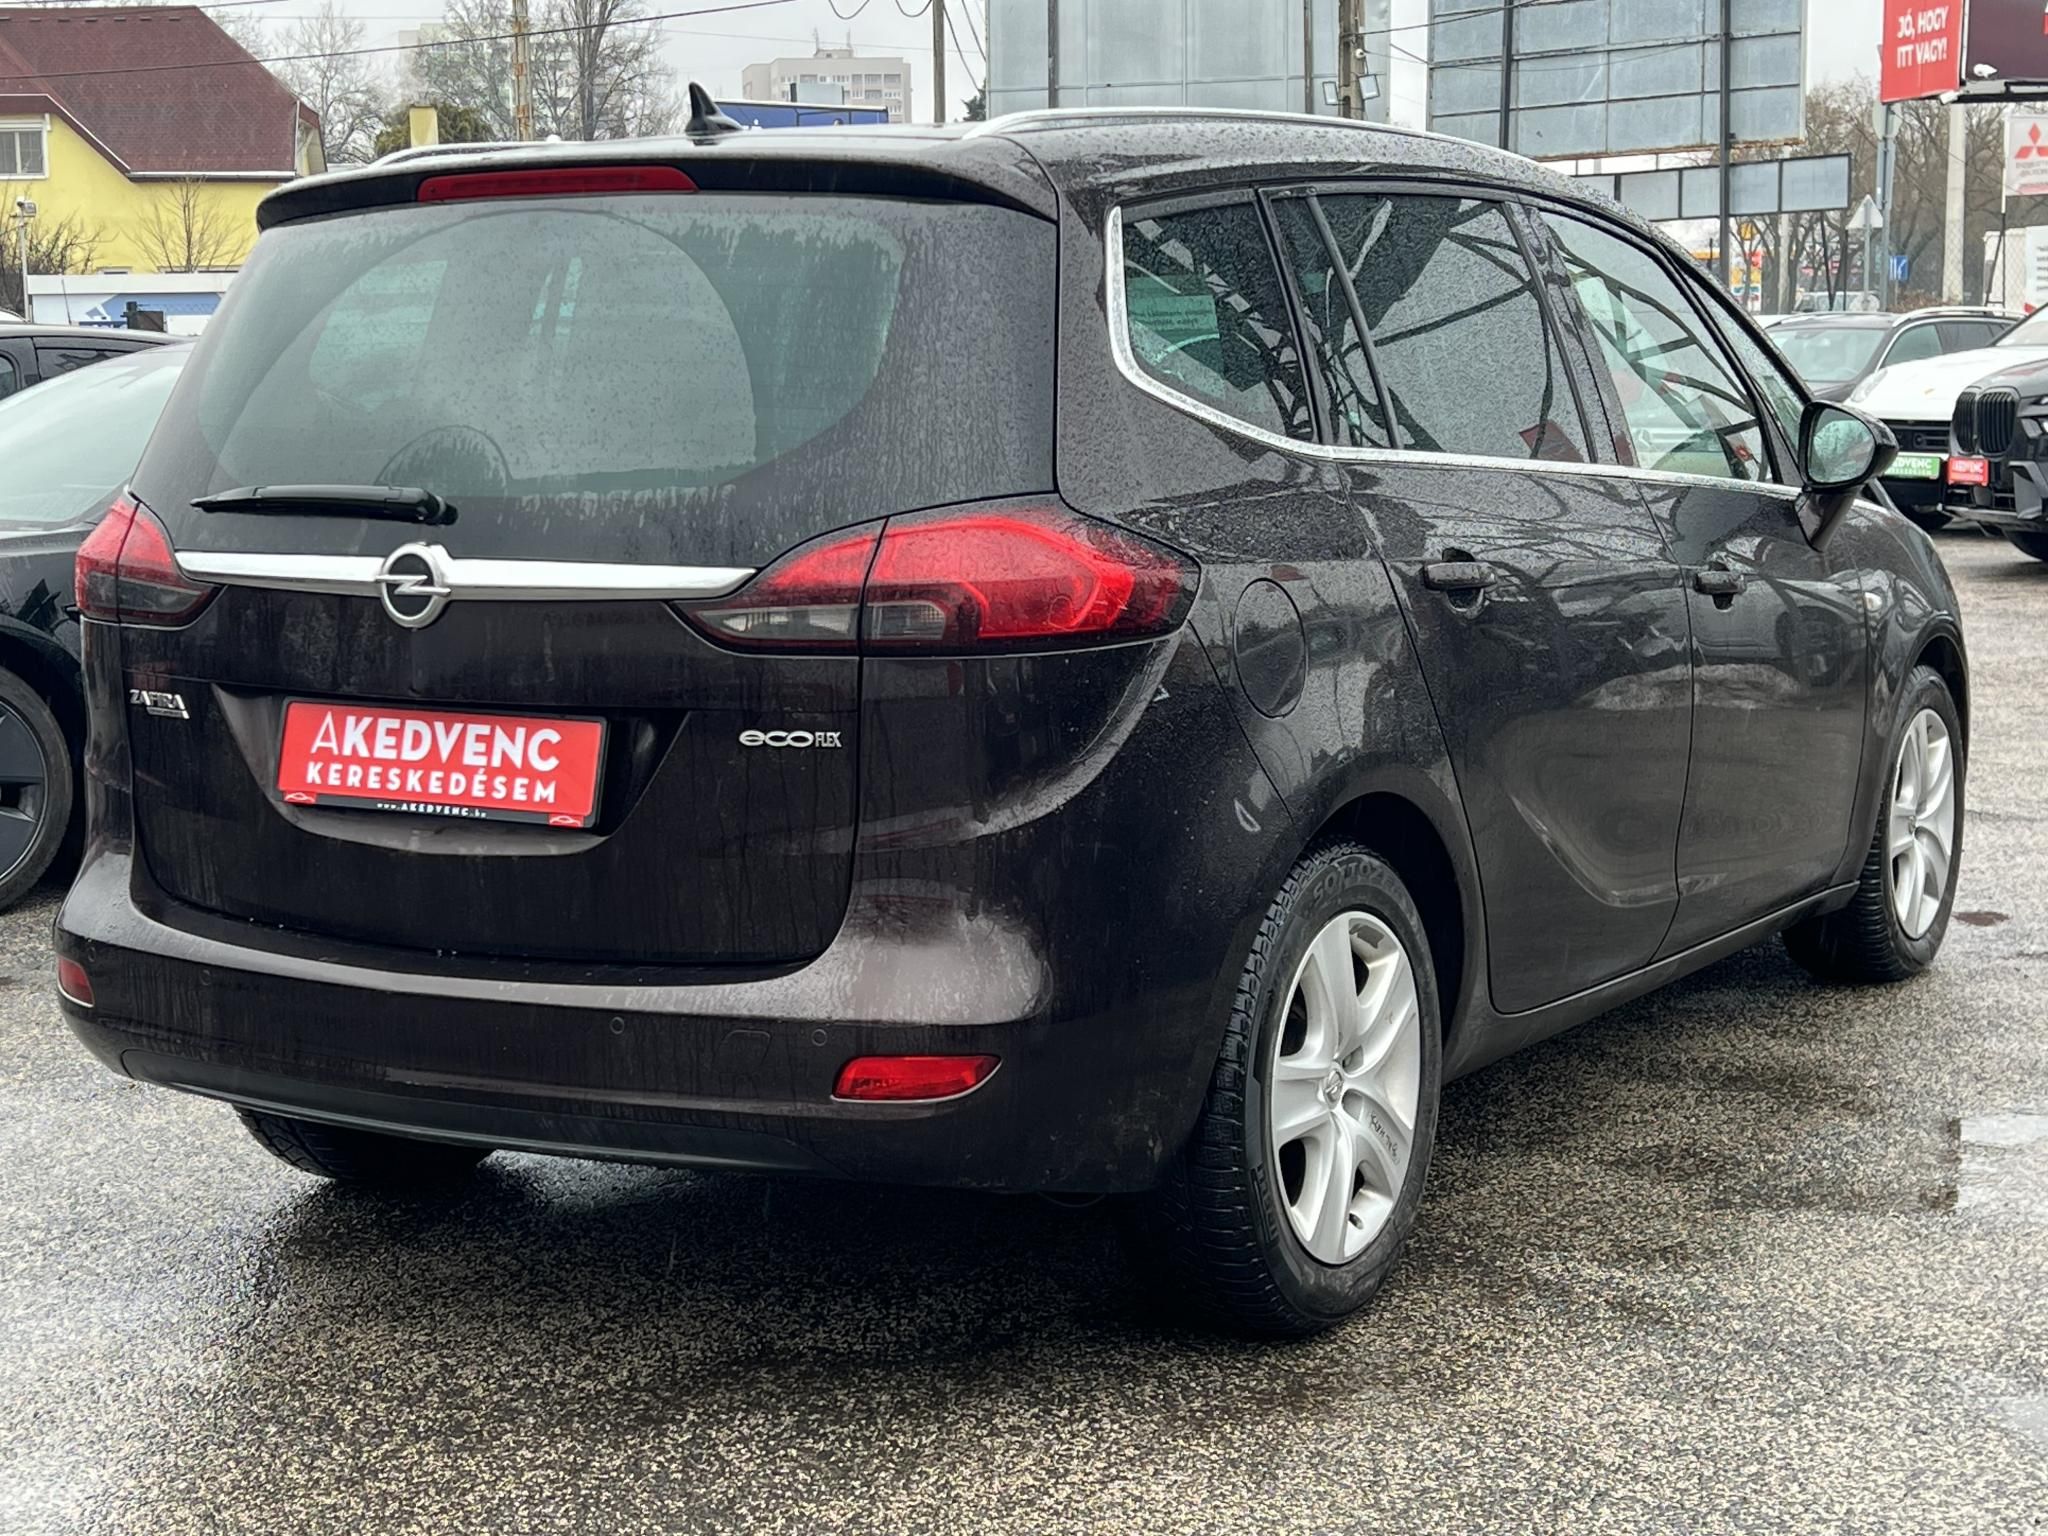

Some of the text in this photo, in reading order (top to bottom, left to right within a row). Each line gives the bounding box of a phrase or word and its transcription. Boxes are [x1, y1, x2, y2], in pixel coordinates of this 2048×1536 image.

[1897, 5, 1949, 40] JÓ, HOGY
[1897, 37, 1948, 69] ITT VAGY!
[311, 711, 562, 771] AKEDVENC
[306, 761, 556, 803] KERESKEDÉSEM
